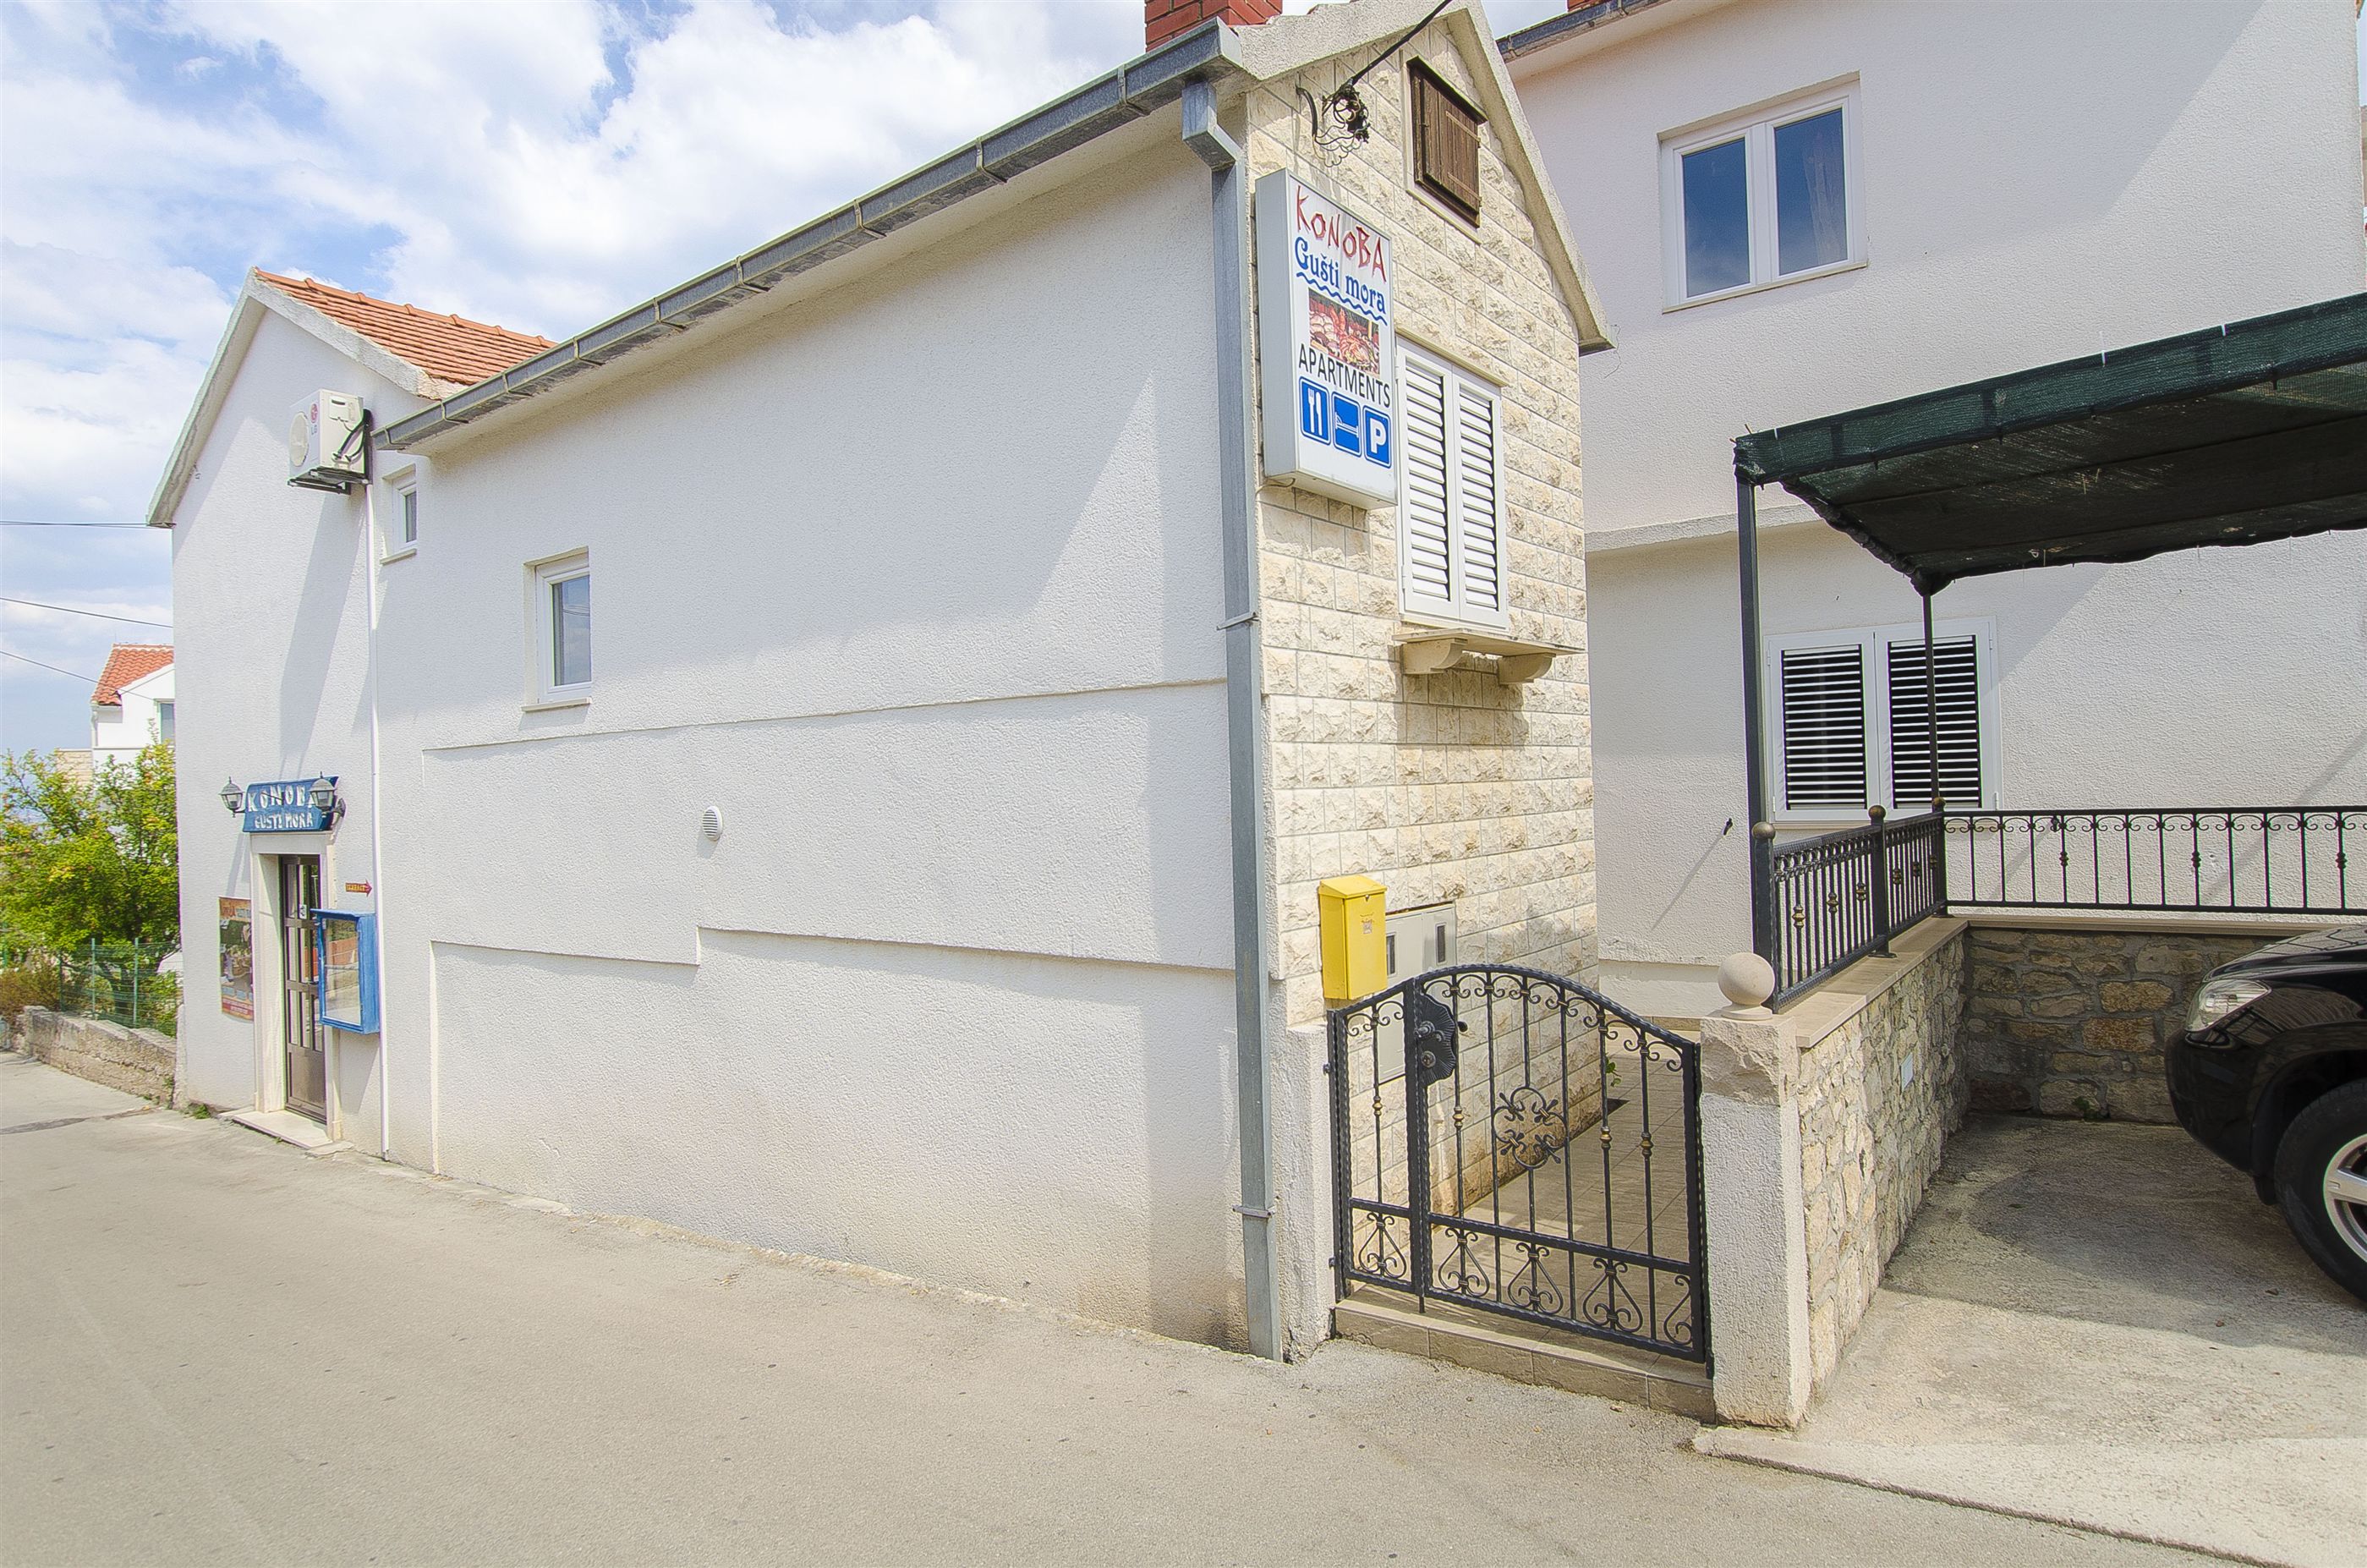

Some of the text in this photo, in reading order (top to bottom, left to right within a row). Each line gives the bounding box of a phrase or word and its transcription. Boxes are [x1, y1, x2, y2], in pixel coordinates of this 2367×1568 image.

[1296, 185, 1387, 283] KONOBA
[1295, 237, 1387, 315] Gušti mora
[1298, 343, 1390, 408] APARTMENTS
[285, 812, 314, 829] MORA
